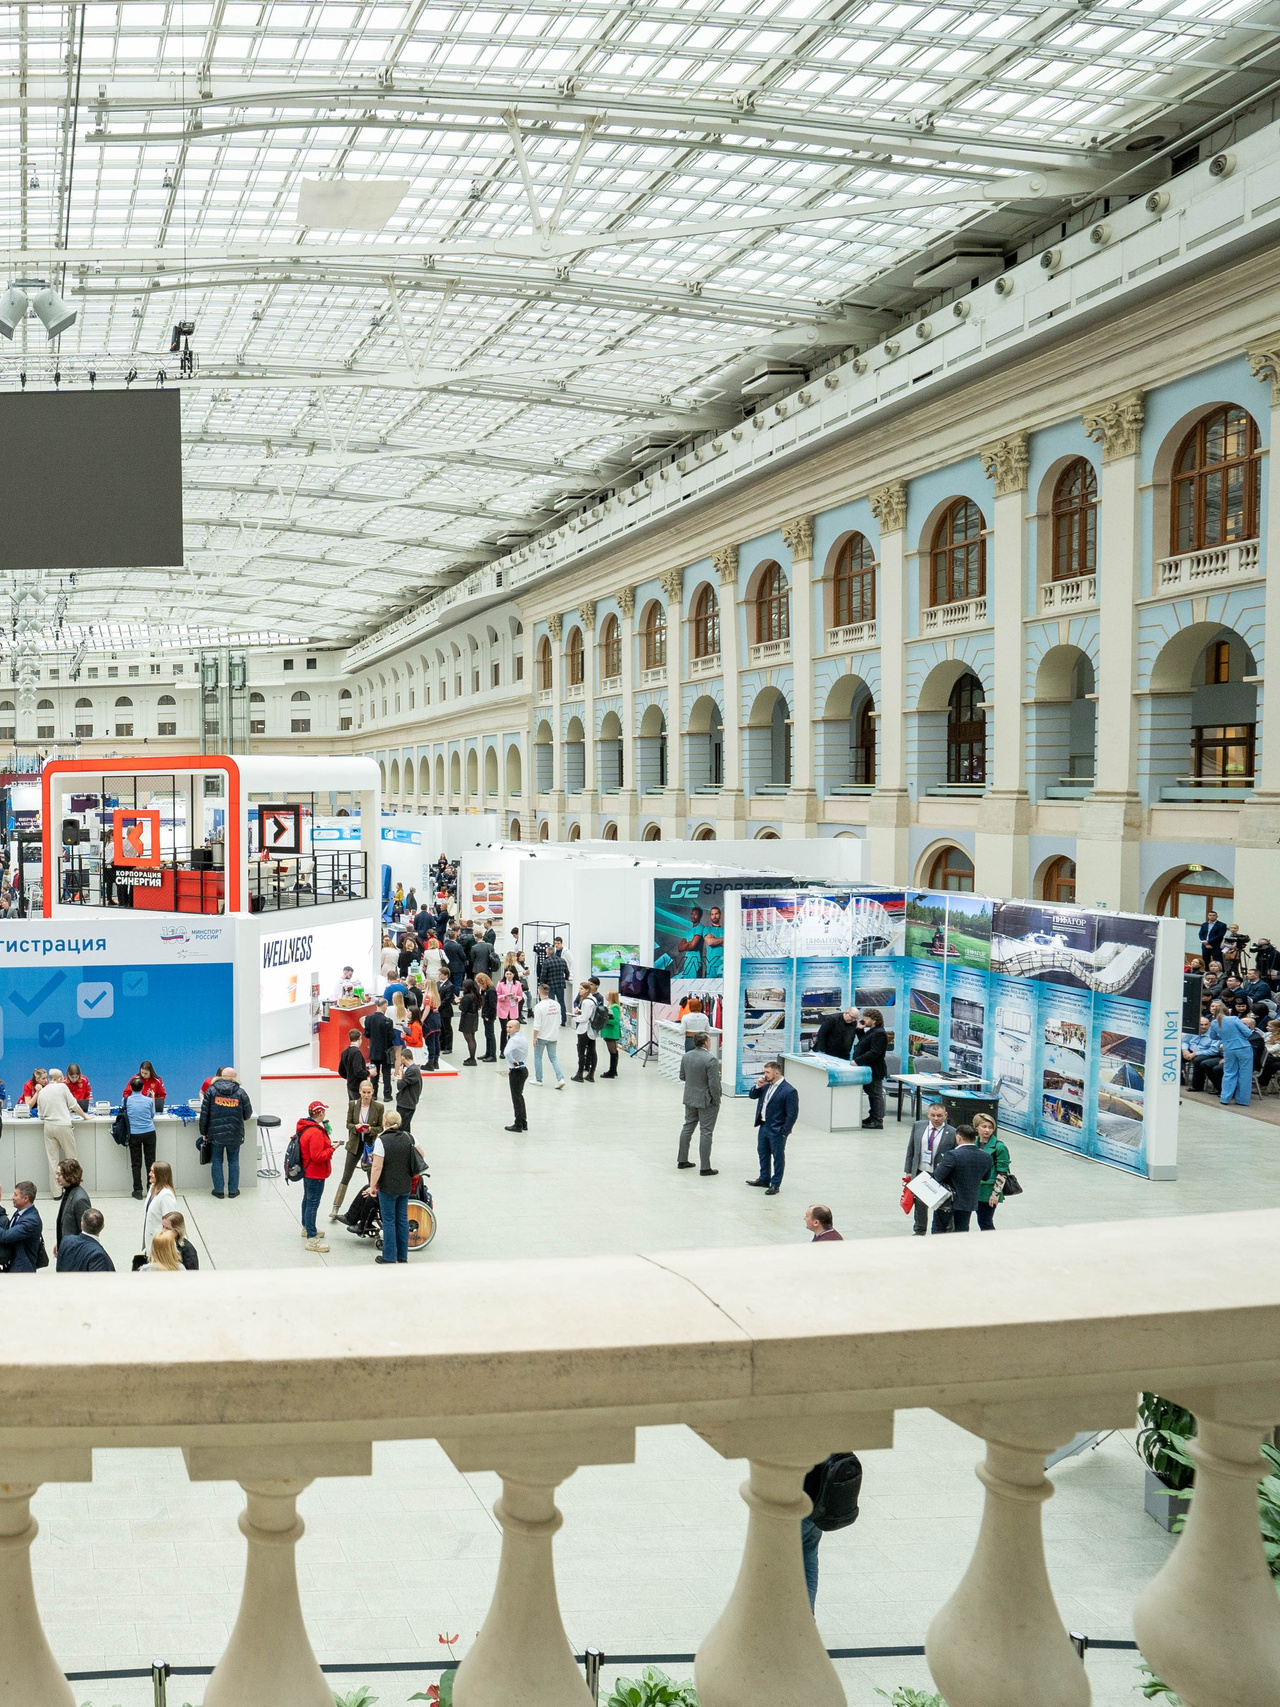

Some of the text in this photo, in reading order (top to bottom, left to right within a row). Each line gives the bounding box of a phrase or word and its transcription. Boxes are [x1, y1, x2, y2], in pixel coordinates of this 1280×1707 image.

[115, 870, 162, 879] КОРПОРАЦИЯ
[115, 876, 162, 887] СИНЕРГИЯ
[1052, 915, 1087, 926] ПИФАГОР
[263, 935, 313, 969] WELLNESS
[1162, 1011, 1179, 1082] ЗАЛ №1
[214, 1096, 239, 1108] RUSSIA
